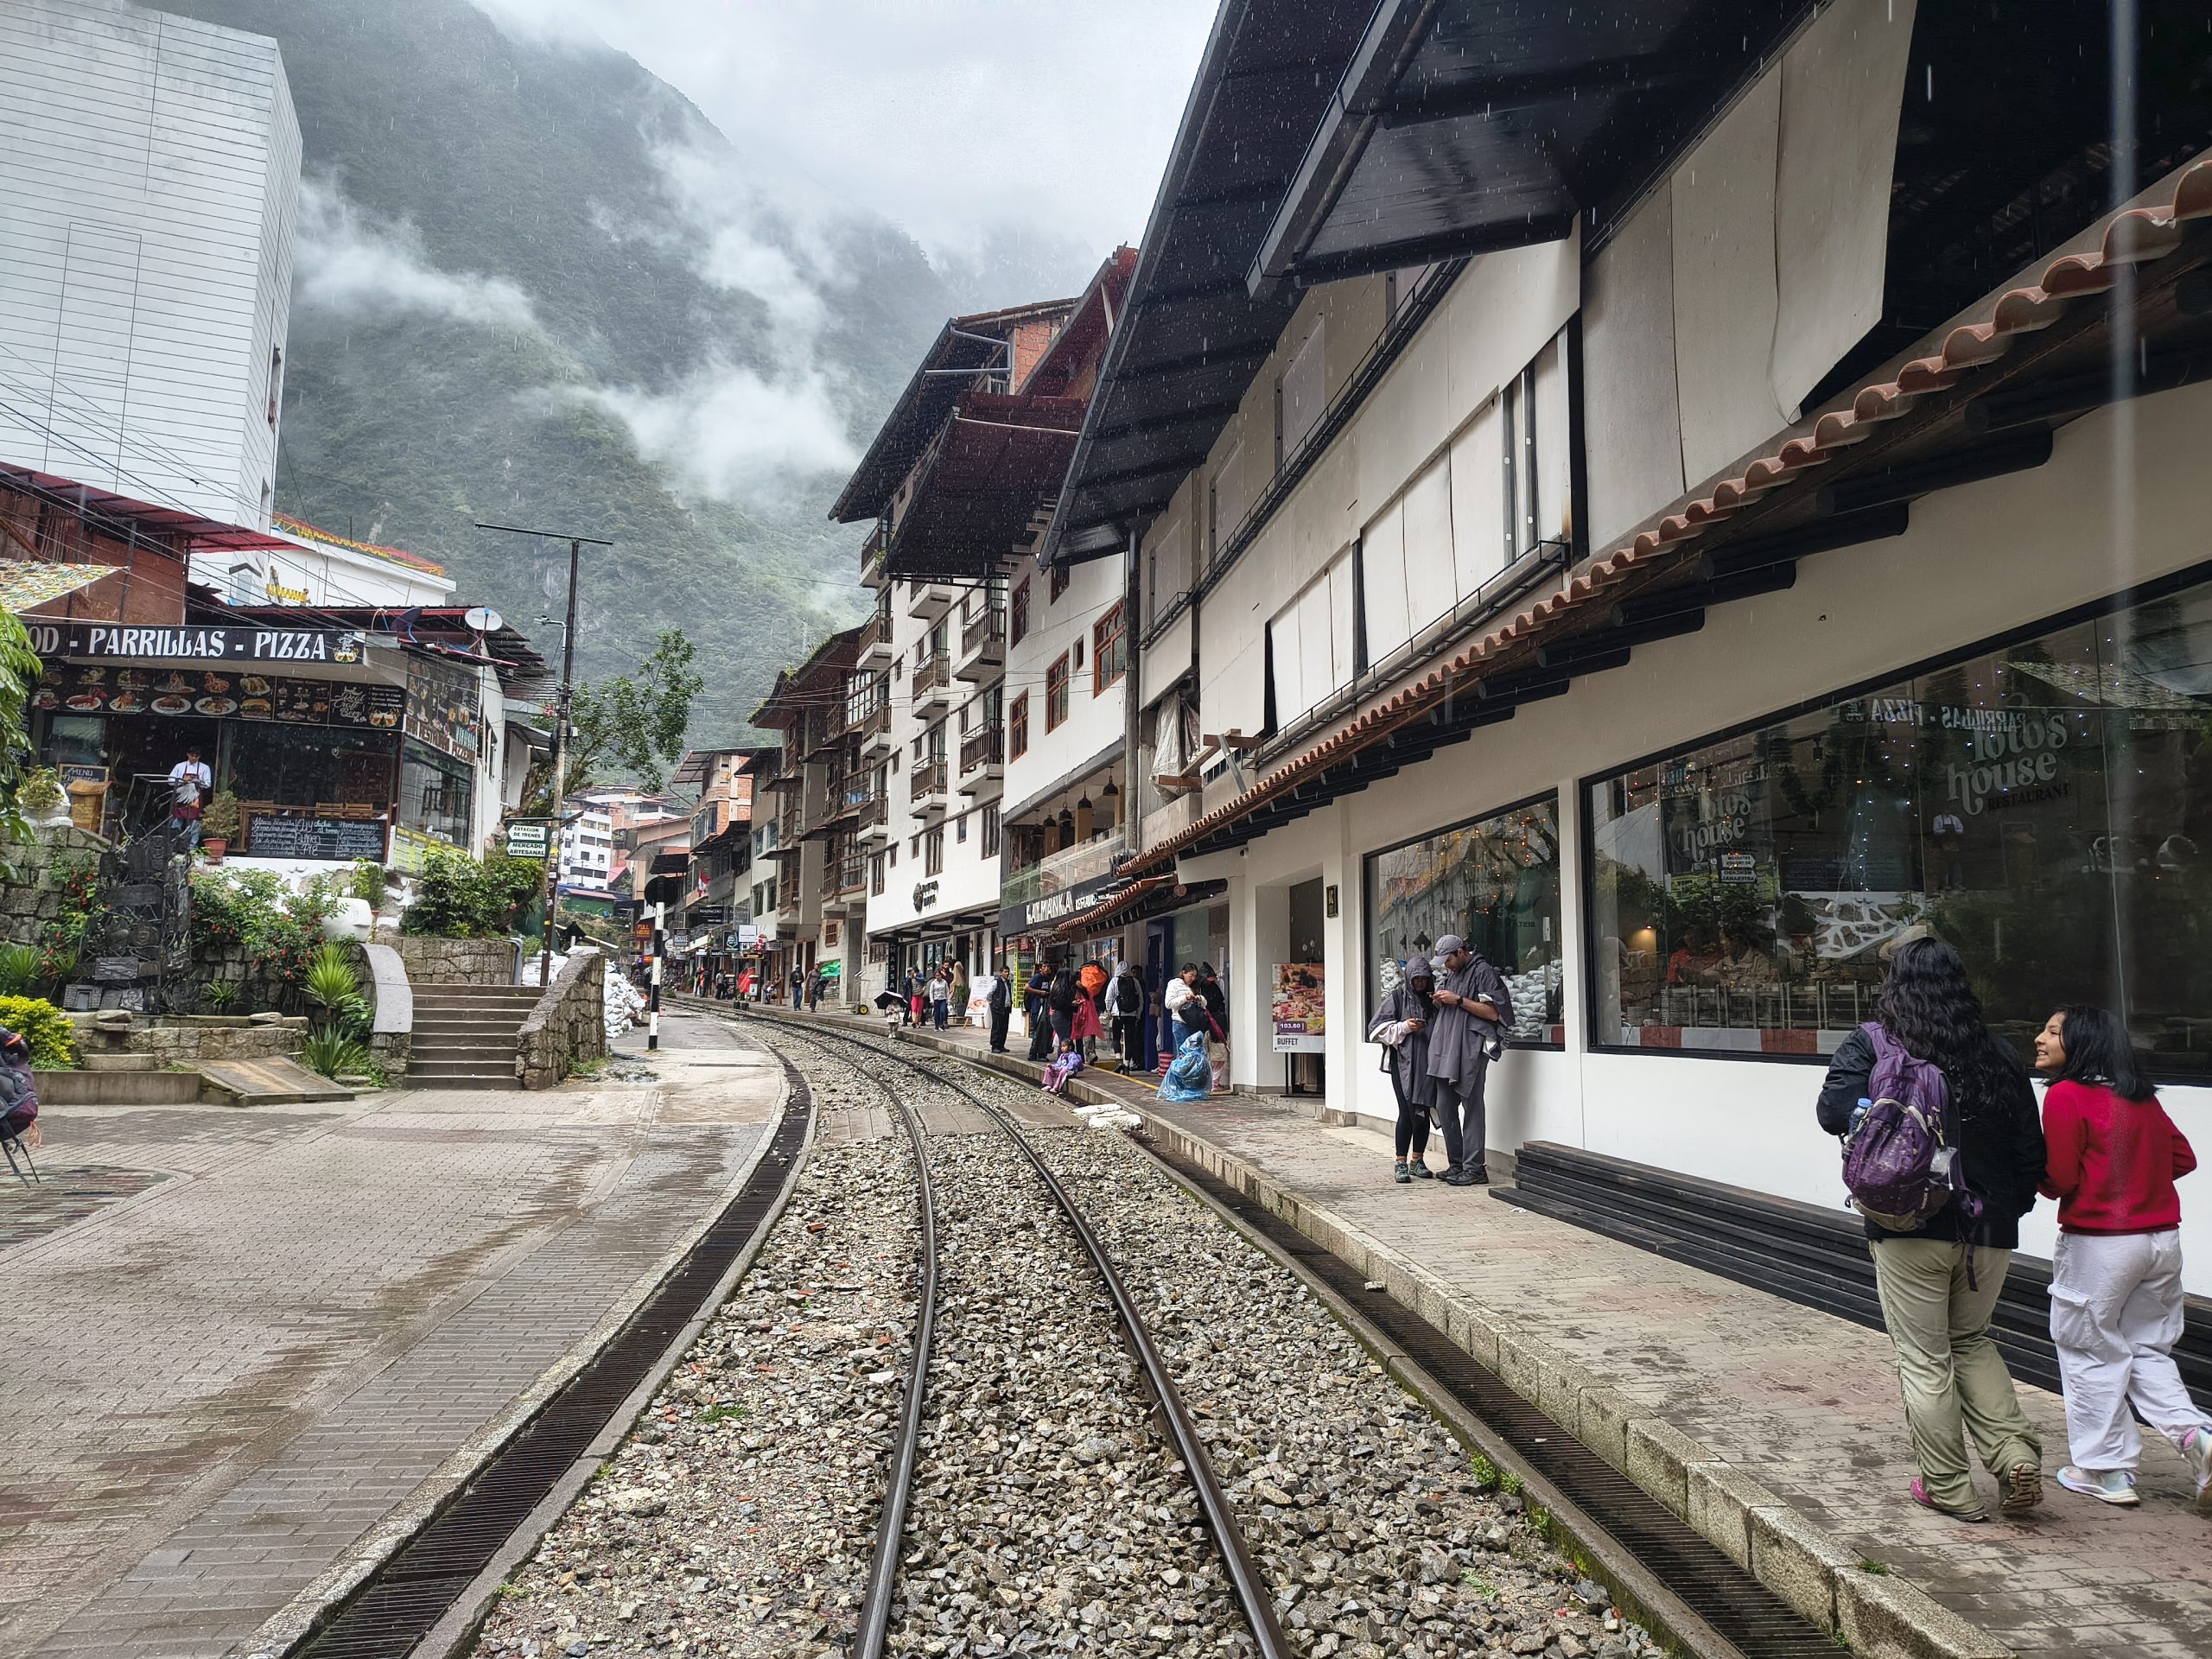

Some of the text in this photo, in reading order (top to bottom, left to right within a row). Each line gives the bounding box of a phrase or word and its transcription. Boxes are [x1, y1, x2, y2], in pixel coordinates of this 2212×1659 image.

[88, 628, 226, 658] PARRILLAS
[254, 632, 326, 660] PIZZA
[1946, 752, 2057, 816] house
[1987, 784, 2070, 810] RESTAURANT
